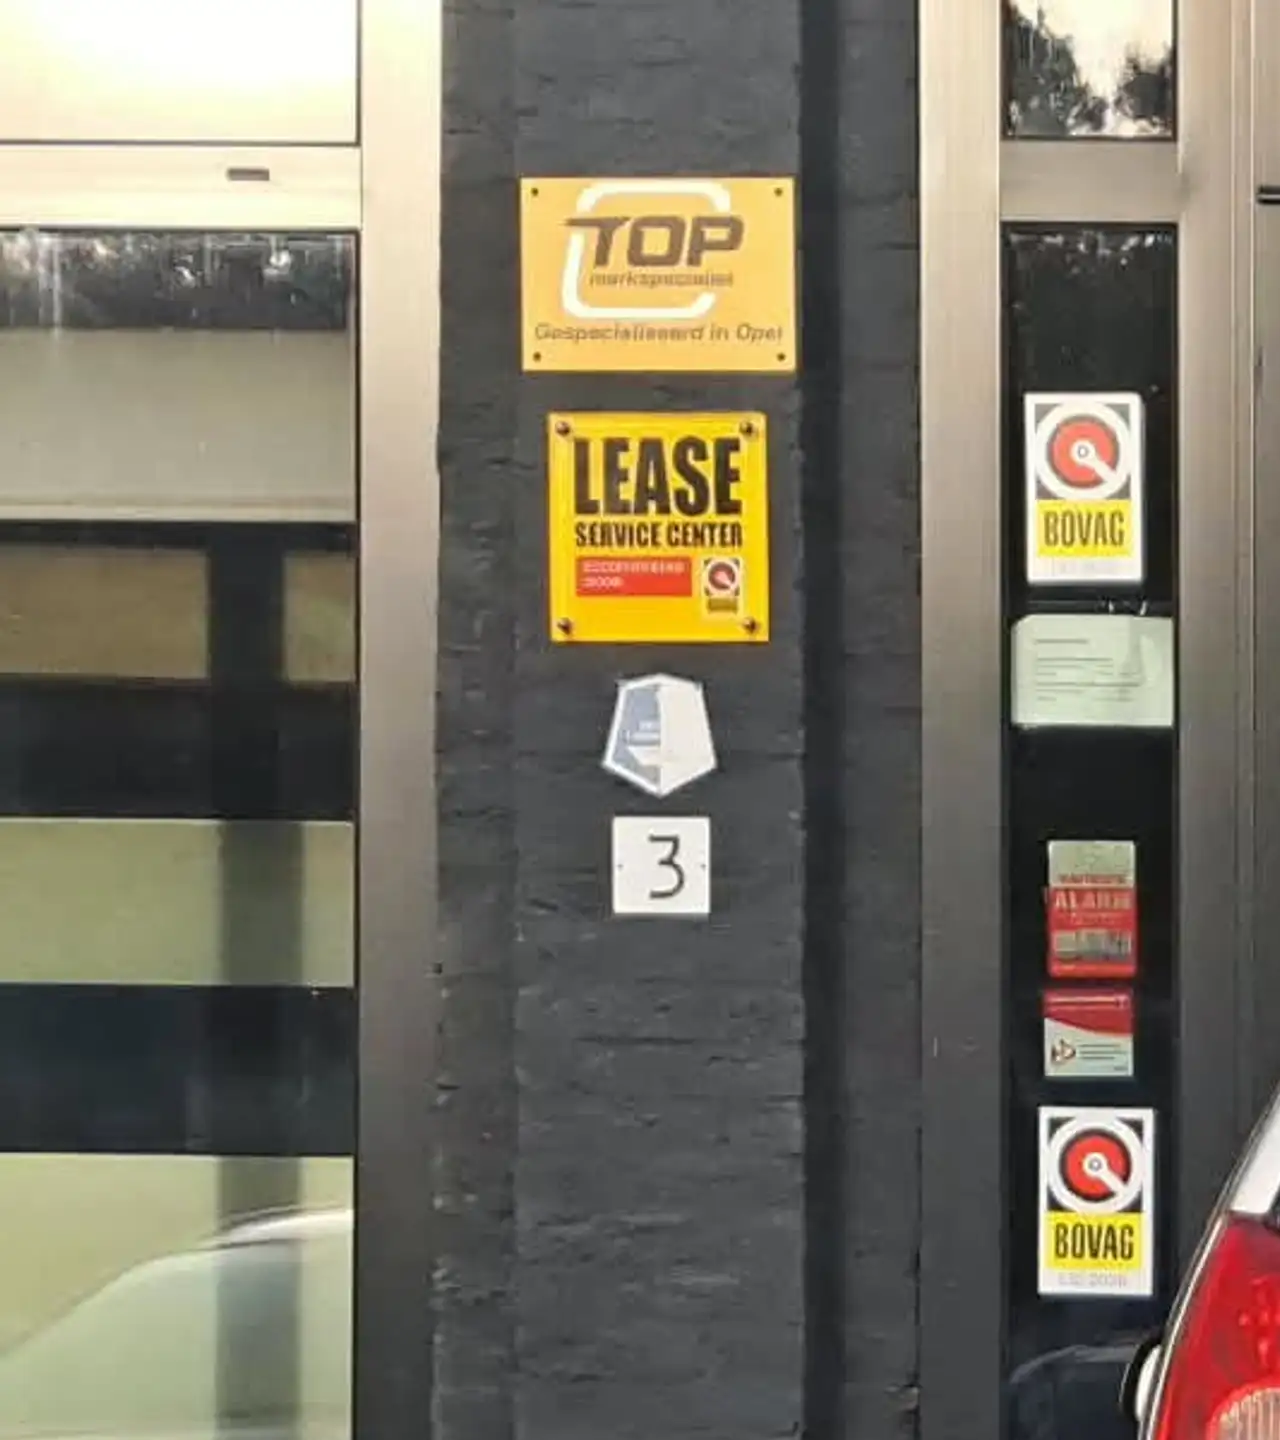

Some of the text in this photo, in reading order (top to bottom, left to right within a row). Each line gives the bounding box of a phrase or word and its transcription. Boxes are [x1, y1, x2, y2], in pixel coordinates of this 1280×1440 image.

[560, 214, 745, 268] TOP
[709, 323, 730, 341] in
[735, 322, 784, 344] Opel
[573, 435, 743, 517] LEASE
[575, 521, 743, 548] SERVICE CENTER
[1043, 509, 1126, 548] BOVAG
[648, 835, 686, 900] 3
[1054, 1222, 1135, 1261] BOVAG
